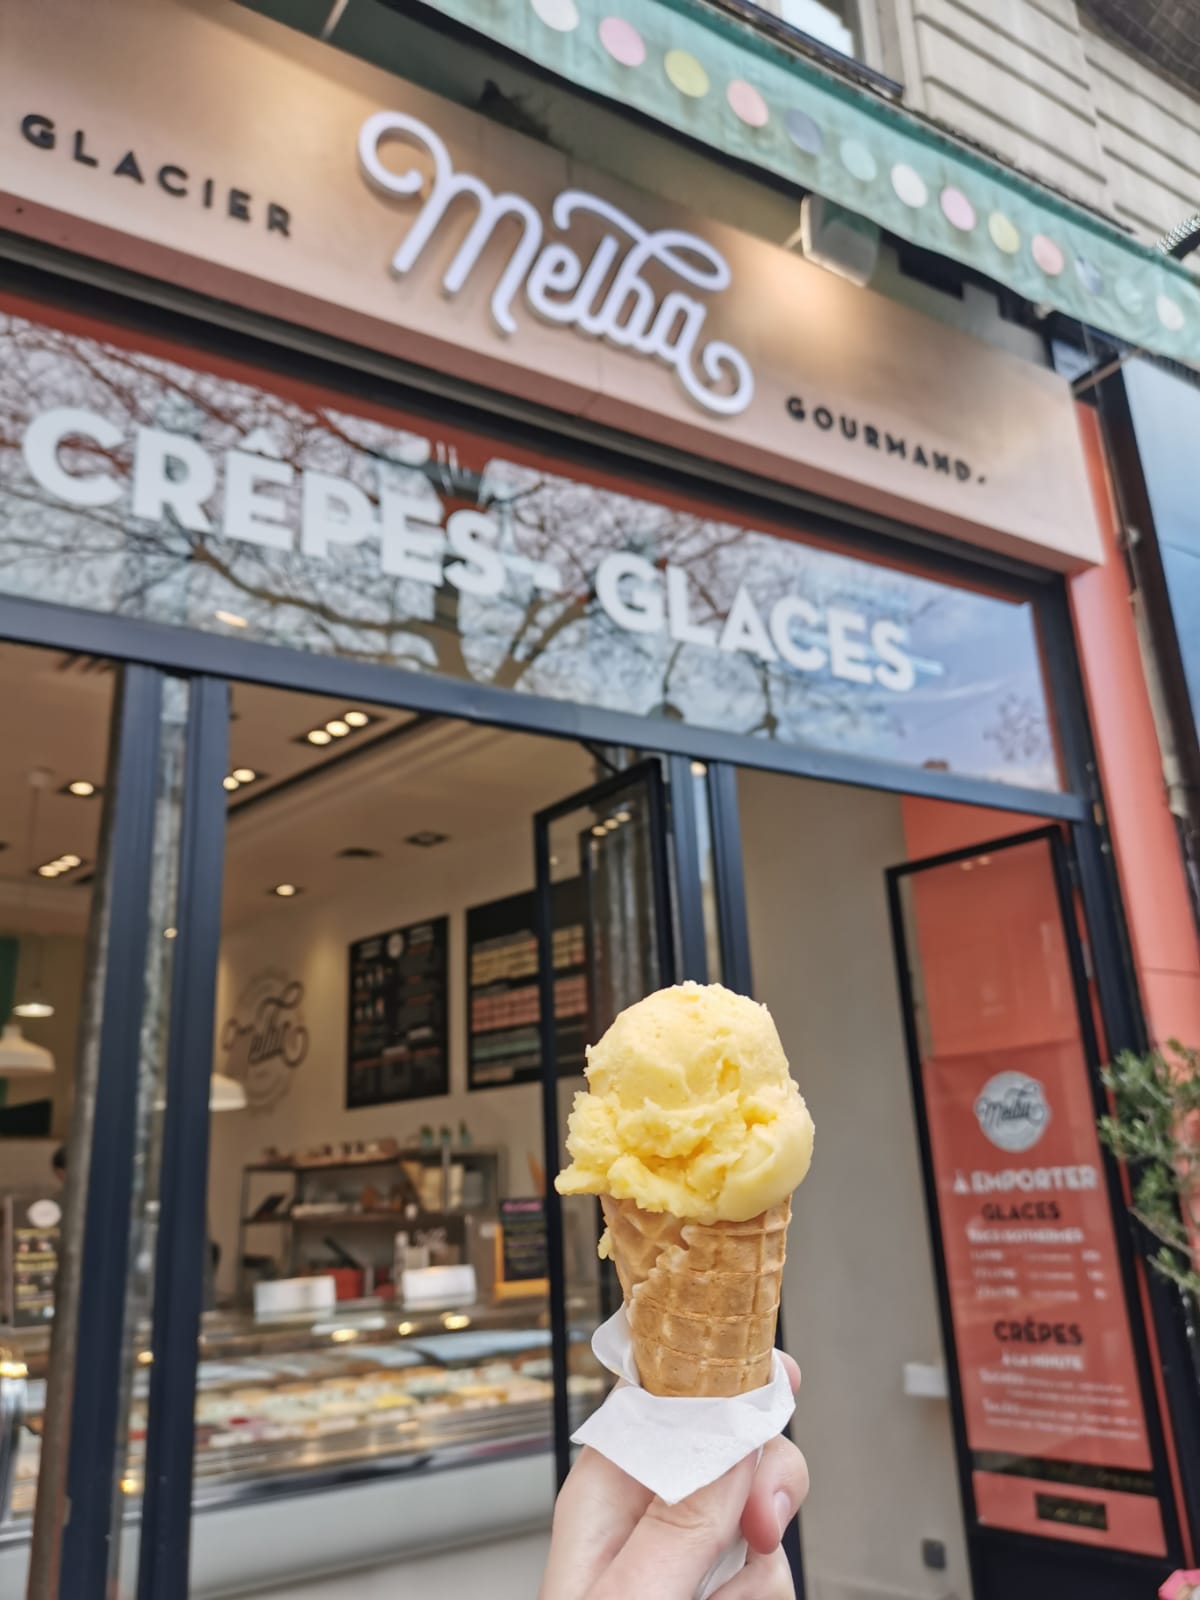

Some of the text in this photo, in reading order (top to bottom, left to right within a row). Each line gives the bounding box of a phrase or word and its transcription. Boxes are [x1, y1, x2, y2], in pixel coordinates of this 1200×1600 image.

[20, 113, 292, 238] GLACIER
[357, 110, 755, 416] Melba
[22, 408, 506, 597] CRÊPES
[595, 551, 916, 692] GLACES
[971, 1165, 1098, 1193] EMPORTER
[982, 1201, 1060, 1220] GLACES
[993, 1316, 1083, 1346] CRÊPES
